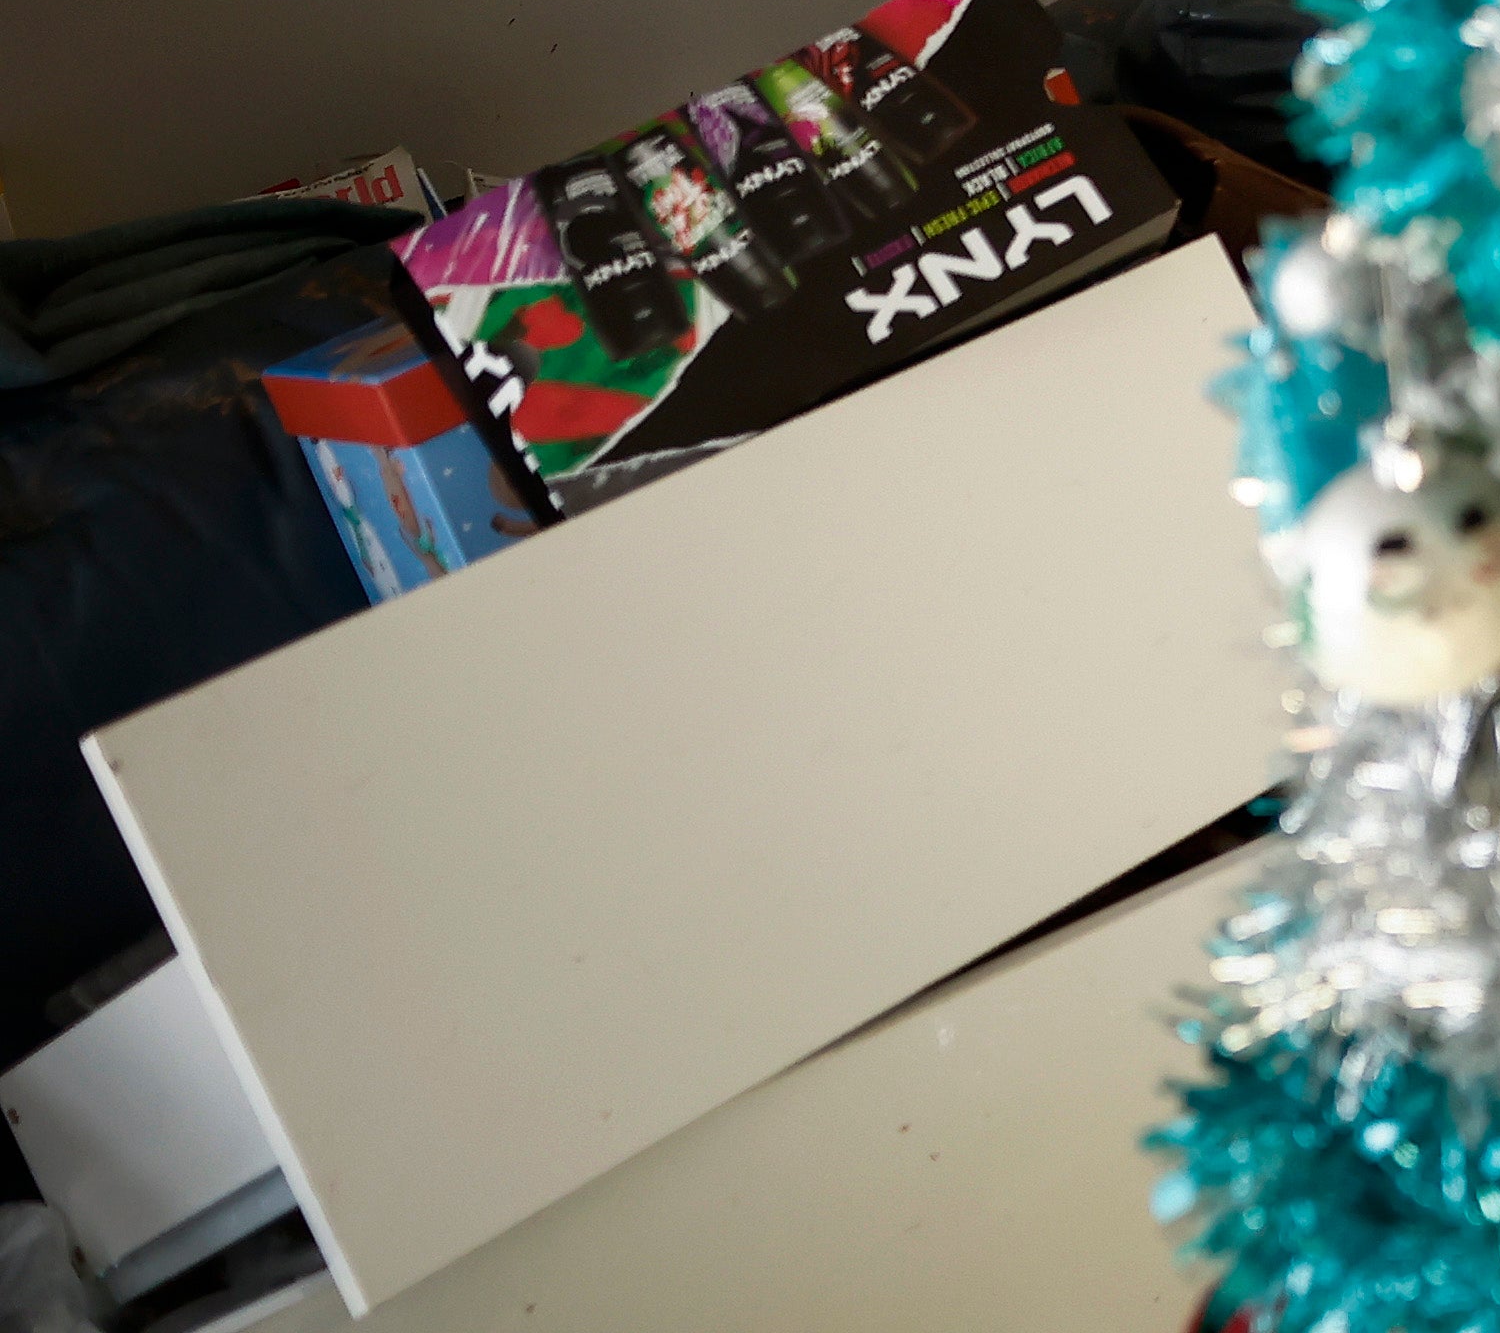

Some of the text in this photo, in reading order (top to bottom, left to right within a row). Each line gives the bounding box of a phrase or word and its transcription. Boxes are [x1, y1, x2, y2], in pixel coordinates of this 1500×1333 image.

[860, 65, 915, 112] LYNX
[735, 157, 806, 198] LYNX
[826, 139, 882, 180] LYNX
[961, 164, 1010, 198] BLACK
[583, 251, 656, 291] LYNX
[691, 228, 752, 274] LYNX
[844, 174, 1114, 345] LYNX
